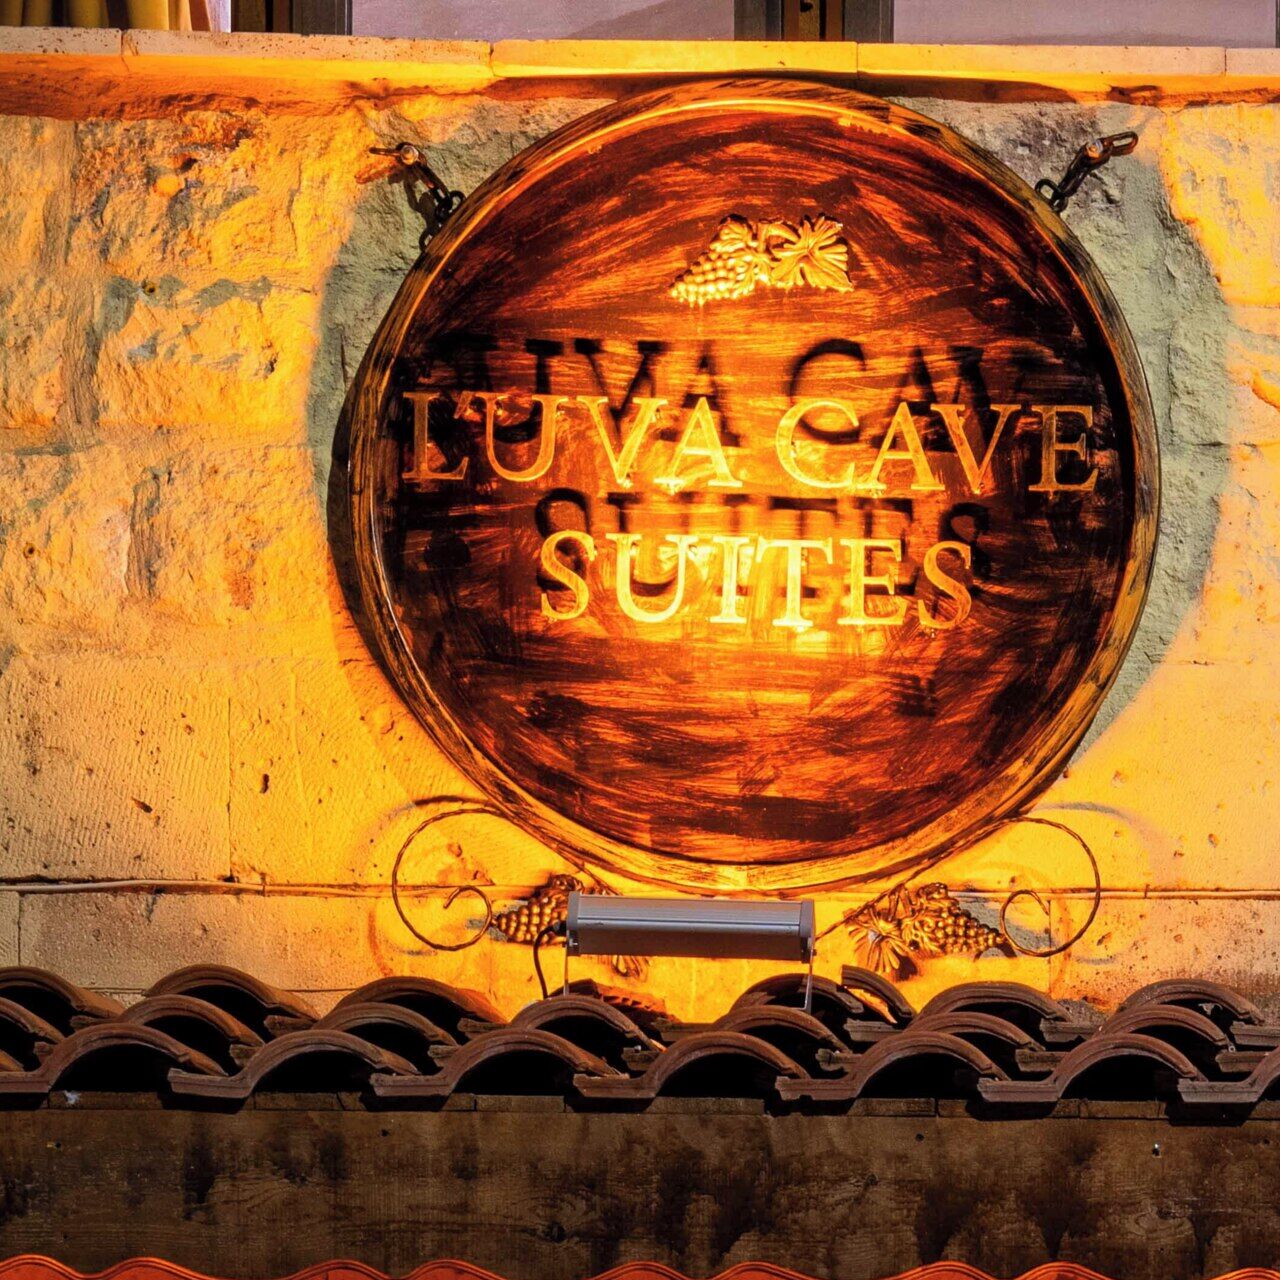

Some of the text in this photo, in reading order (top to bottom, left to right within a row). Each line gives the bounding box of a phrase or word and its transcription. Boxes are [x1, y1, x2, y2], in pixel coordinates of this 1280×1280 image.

[402, 390, 1099, 494] LUVA CAVE
[540, 530, 975, 631] SUITES
